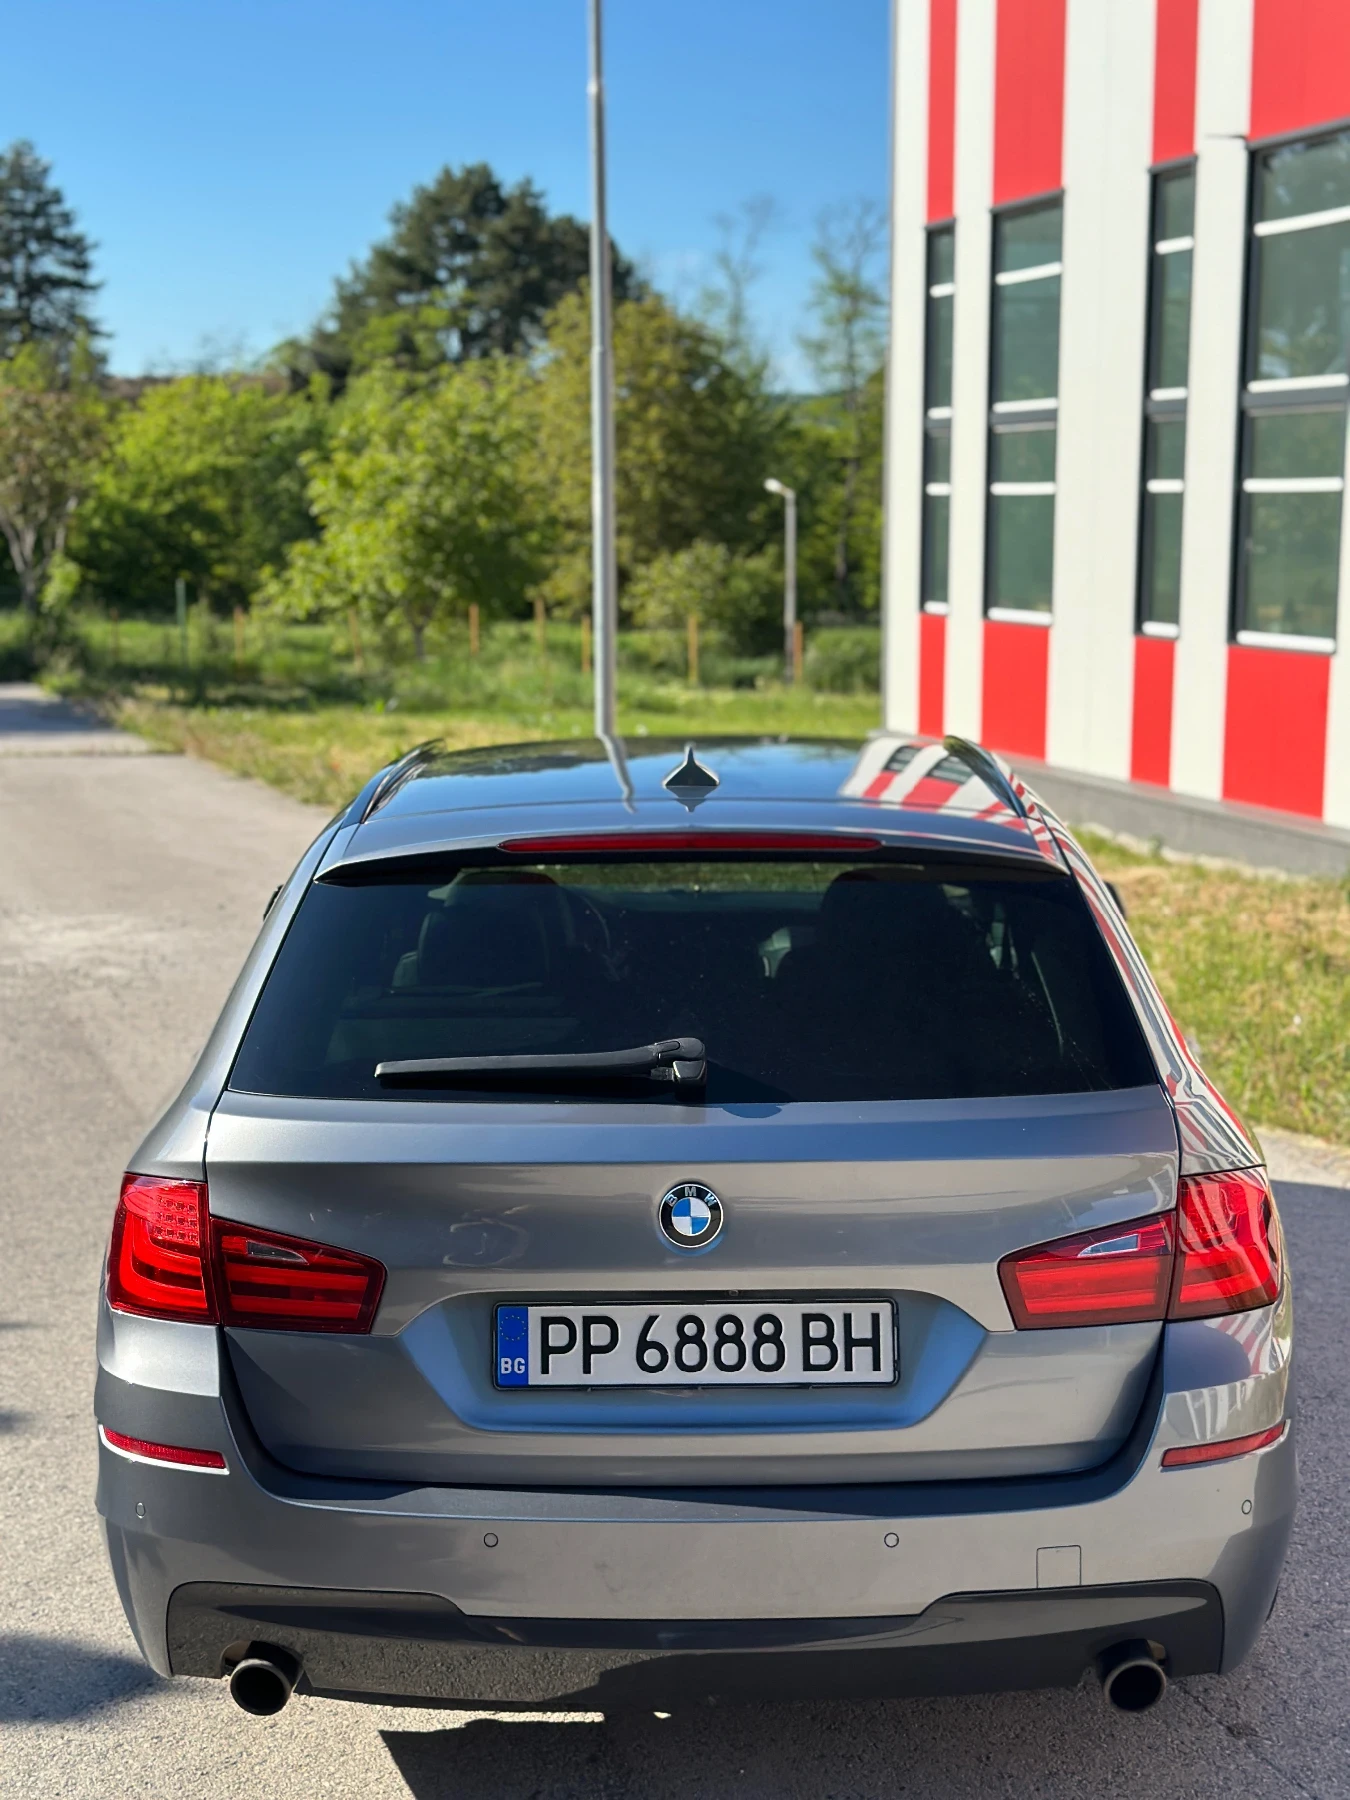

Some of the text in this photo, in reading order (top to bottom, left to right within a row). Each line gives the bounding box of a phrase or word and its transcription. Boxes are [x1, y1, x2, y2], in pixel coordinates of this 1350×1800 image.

[665, 1186, 717, 1207] BMW
[540, 1312, 881, 1375] PP 6888 BH
[500, 1357, 526, 1374] BG
